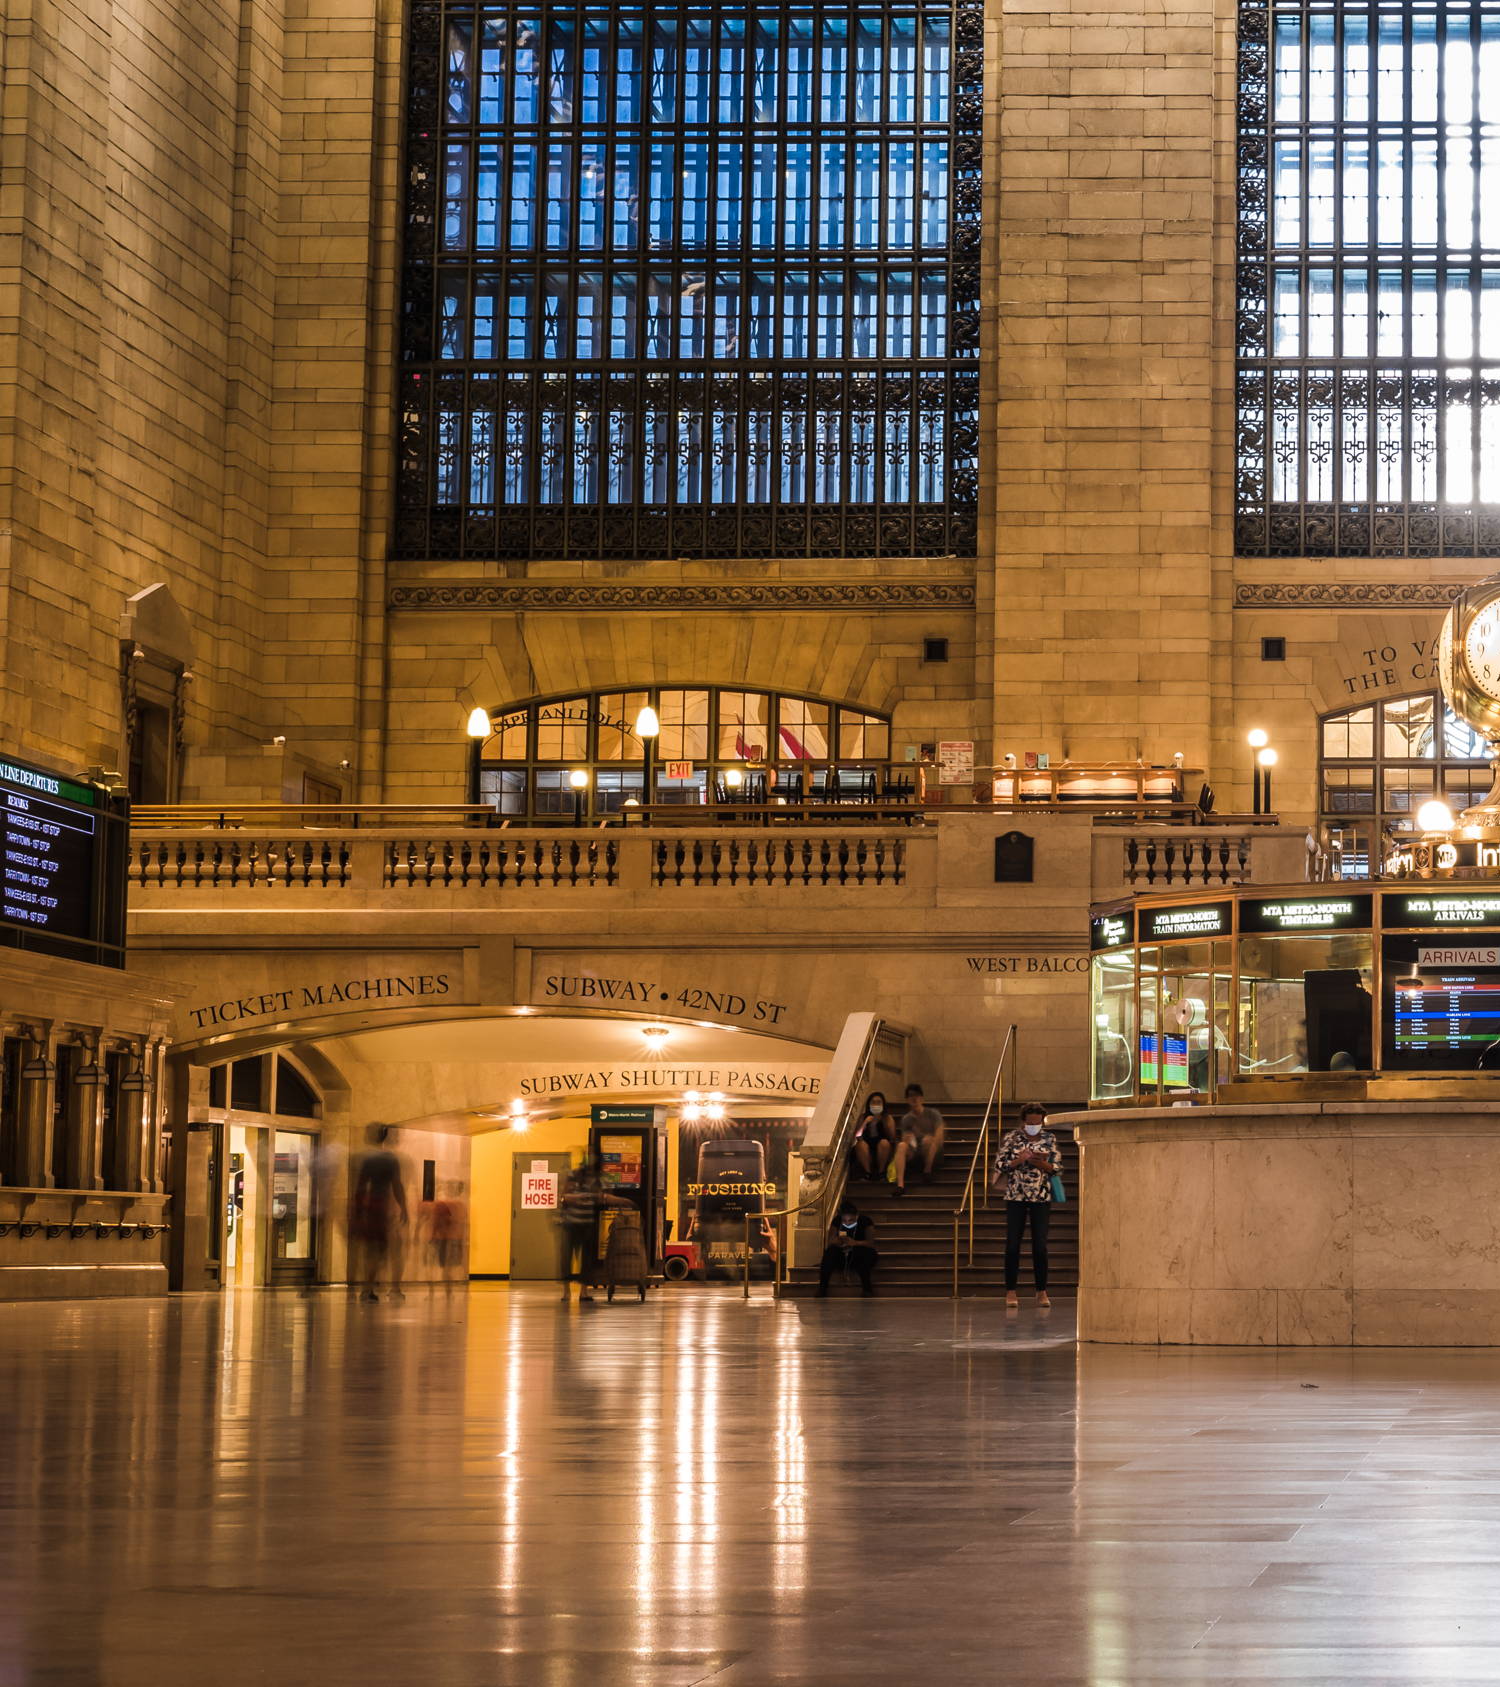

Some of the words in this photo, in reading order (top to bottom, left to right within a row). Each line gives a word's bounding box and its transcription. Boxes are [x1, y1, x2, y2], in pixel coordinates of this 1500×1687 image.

[1480, 623, 1491, 636] 10
[1363, 646, 1397, 666] TO
[1477, 643, 1485, 657] 9
[1483, 665, 1491, 679] 8
[1343, 669, 1397, 694] THE
[669, 763, 691, 778] EXIT
[5, 765, 20, 782] LINE
[20, 770, 59, 795] DEPARTURES
[1262, 906, 1282, 916] MTA
[1283, 903, 1352, 915] METRO-NORTH
[1408, 901, 1431, 911] MTA
[1155, 915, 1170, 925] MTA
[1170, 911, 1218, 923] METRO-NORTH
[1434, 911, 1485, 920] ARRIVALS
[1153, 924, 1173, 935] TRAIN
[1173, 920, 1221, 933] INFORMATION
[1422, 950, 1496, 963] ARRIVALS
[967, 957, 1021, 972] WEST
[1026, 957, 1090, 972] BALCO
[189, 990, 294, 1029] TICKET
[300, 974, 449, 1007] MACHINES
[545, 976, 657, 1002] SUBWAY
[677, 989, 747, 1015] 42ND
[753, 1001, 787, 1024] ST
[520, 1071, 614, 1096] SUBWAY
[620, 1070, 720, 1087] SHUTTLE
[727, 1071, 821, 1095] PASSAGE
[528, 1178, 552, 1190] FIRE
[687, 1182, 776, 1196] FLUSHING
[524, 1193, 555, 1205] HOSE
